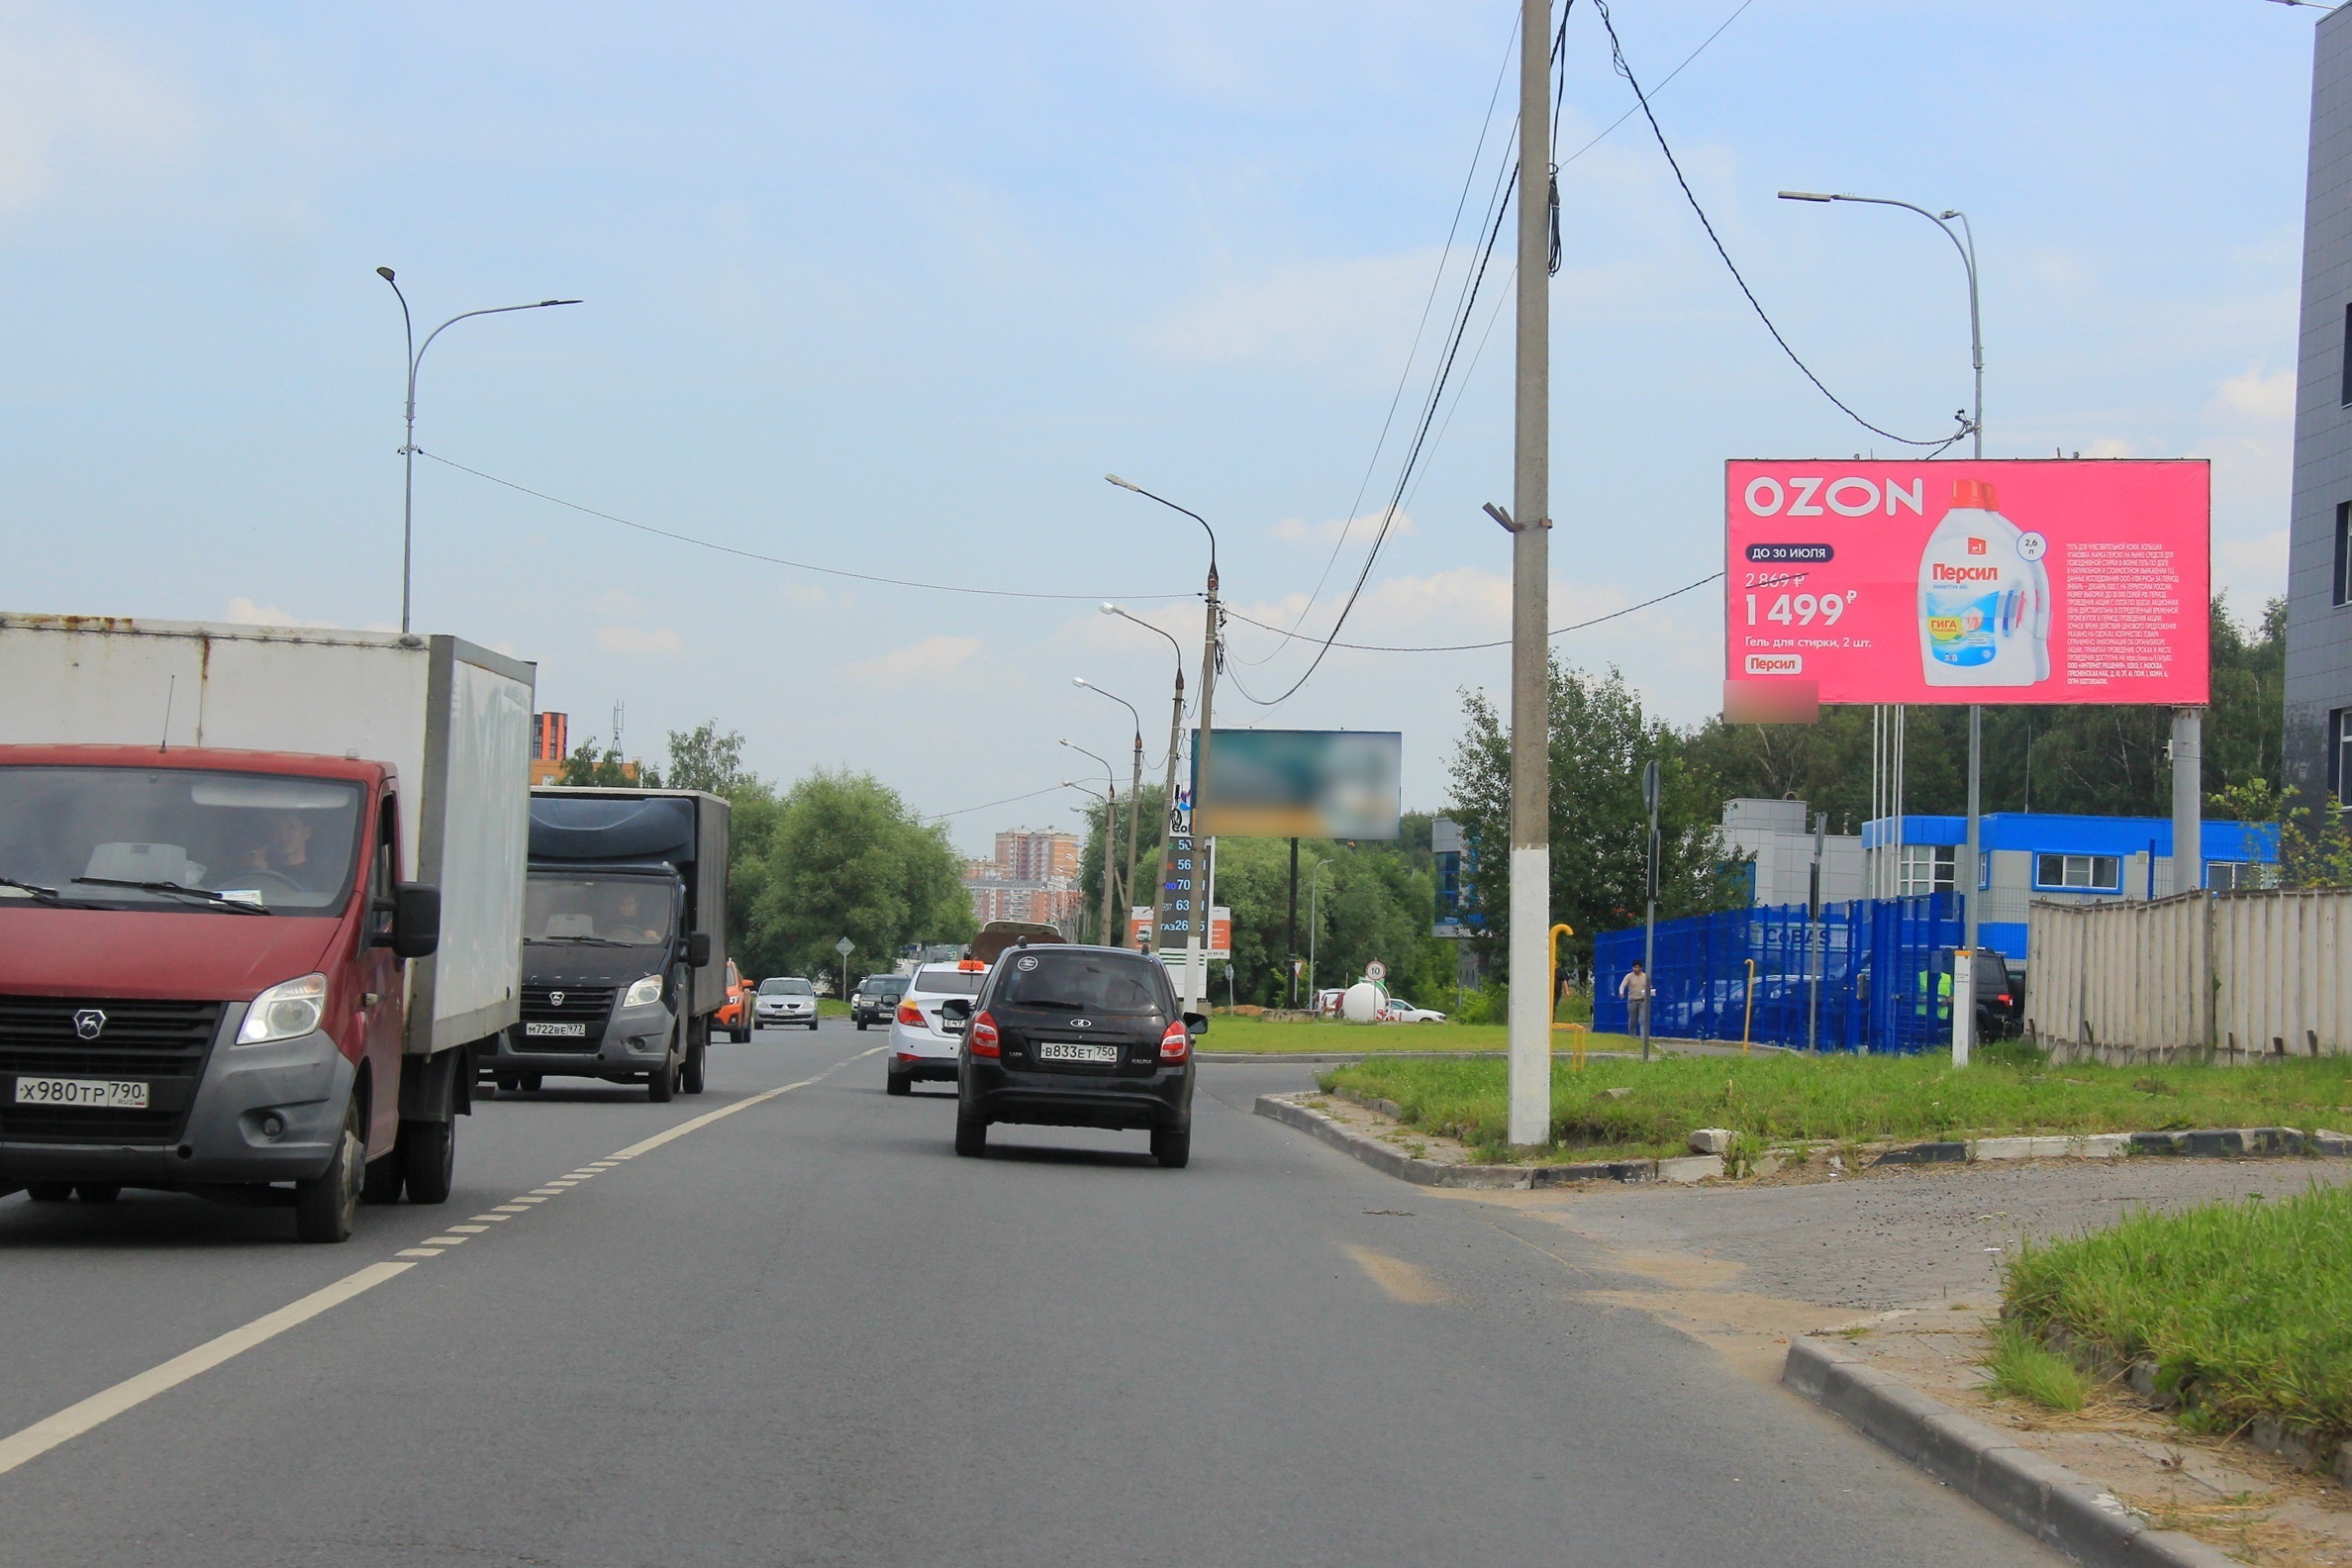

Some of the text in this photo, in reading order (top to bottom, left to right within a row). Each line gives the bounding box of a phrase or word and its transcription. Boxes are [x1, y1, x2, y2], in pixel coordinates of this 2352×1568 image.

[1744, 476, 1923, 517] OZON
[2024, 539, 2038, 547] 2,6
[1751, 547, 1825, 559] ДО 30 ИЮЛЯ
[1932, 563, 1998, 584] Персил
[1930, 620, 1957, 629] ГИГА
[1745, 637, 1872, 649] Гель для стирки, 2 шт.
[1750, 657, 1796, 671] Персил
[529, 1024, 583, 1035] М722ВЕ 977
[1045, 1045, 1115, 1059] В833ЕТ 750
[23, 1081, 142, 1103] Х980ТР 790
